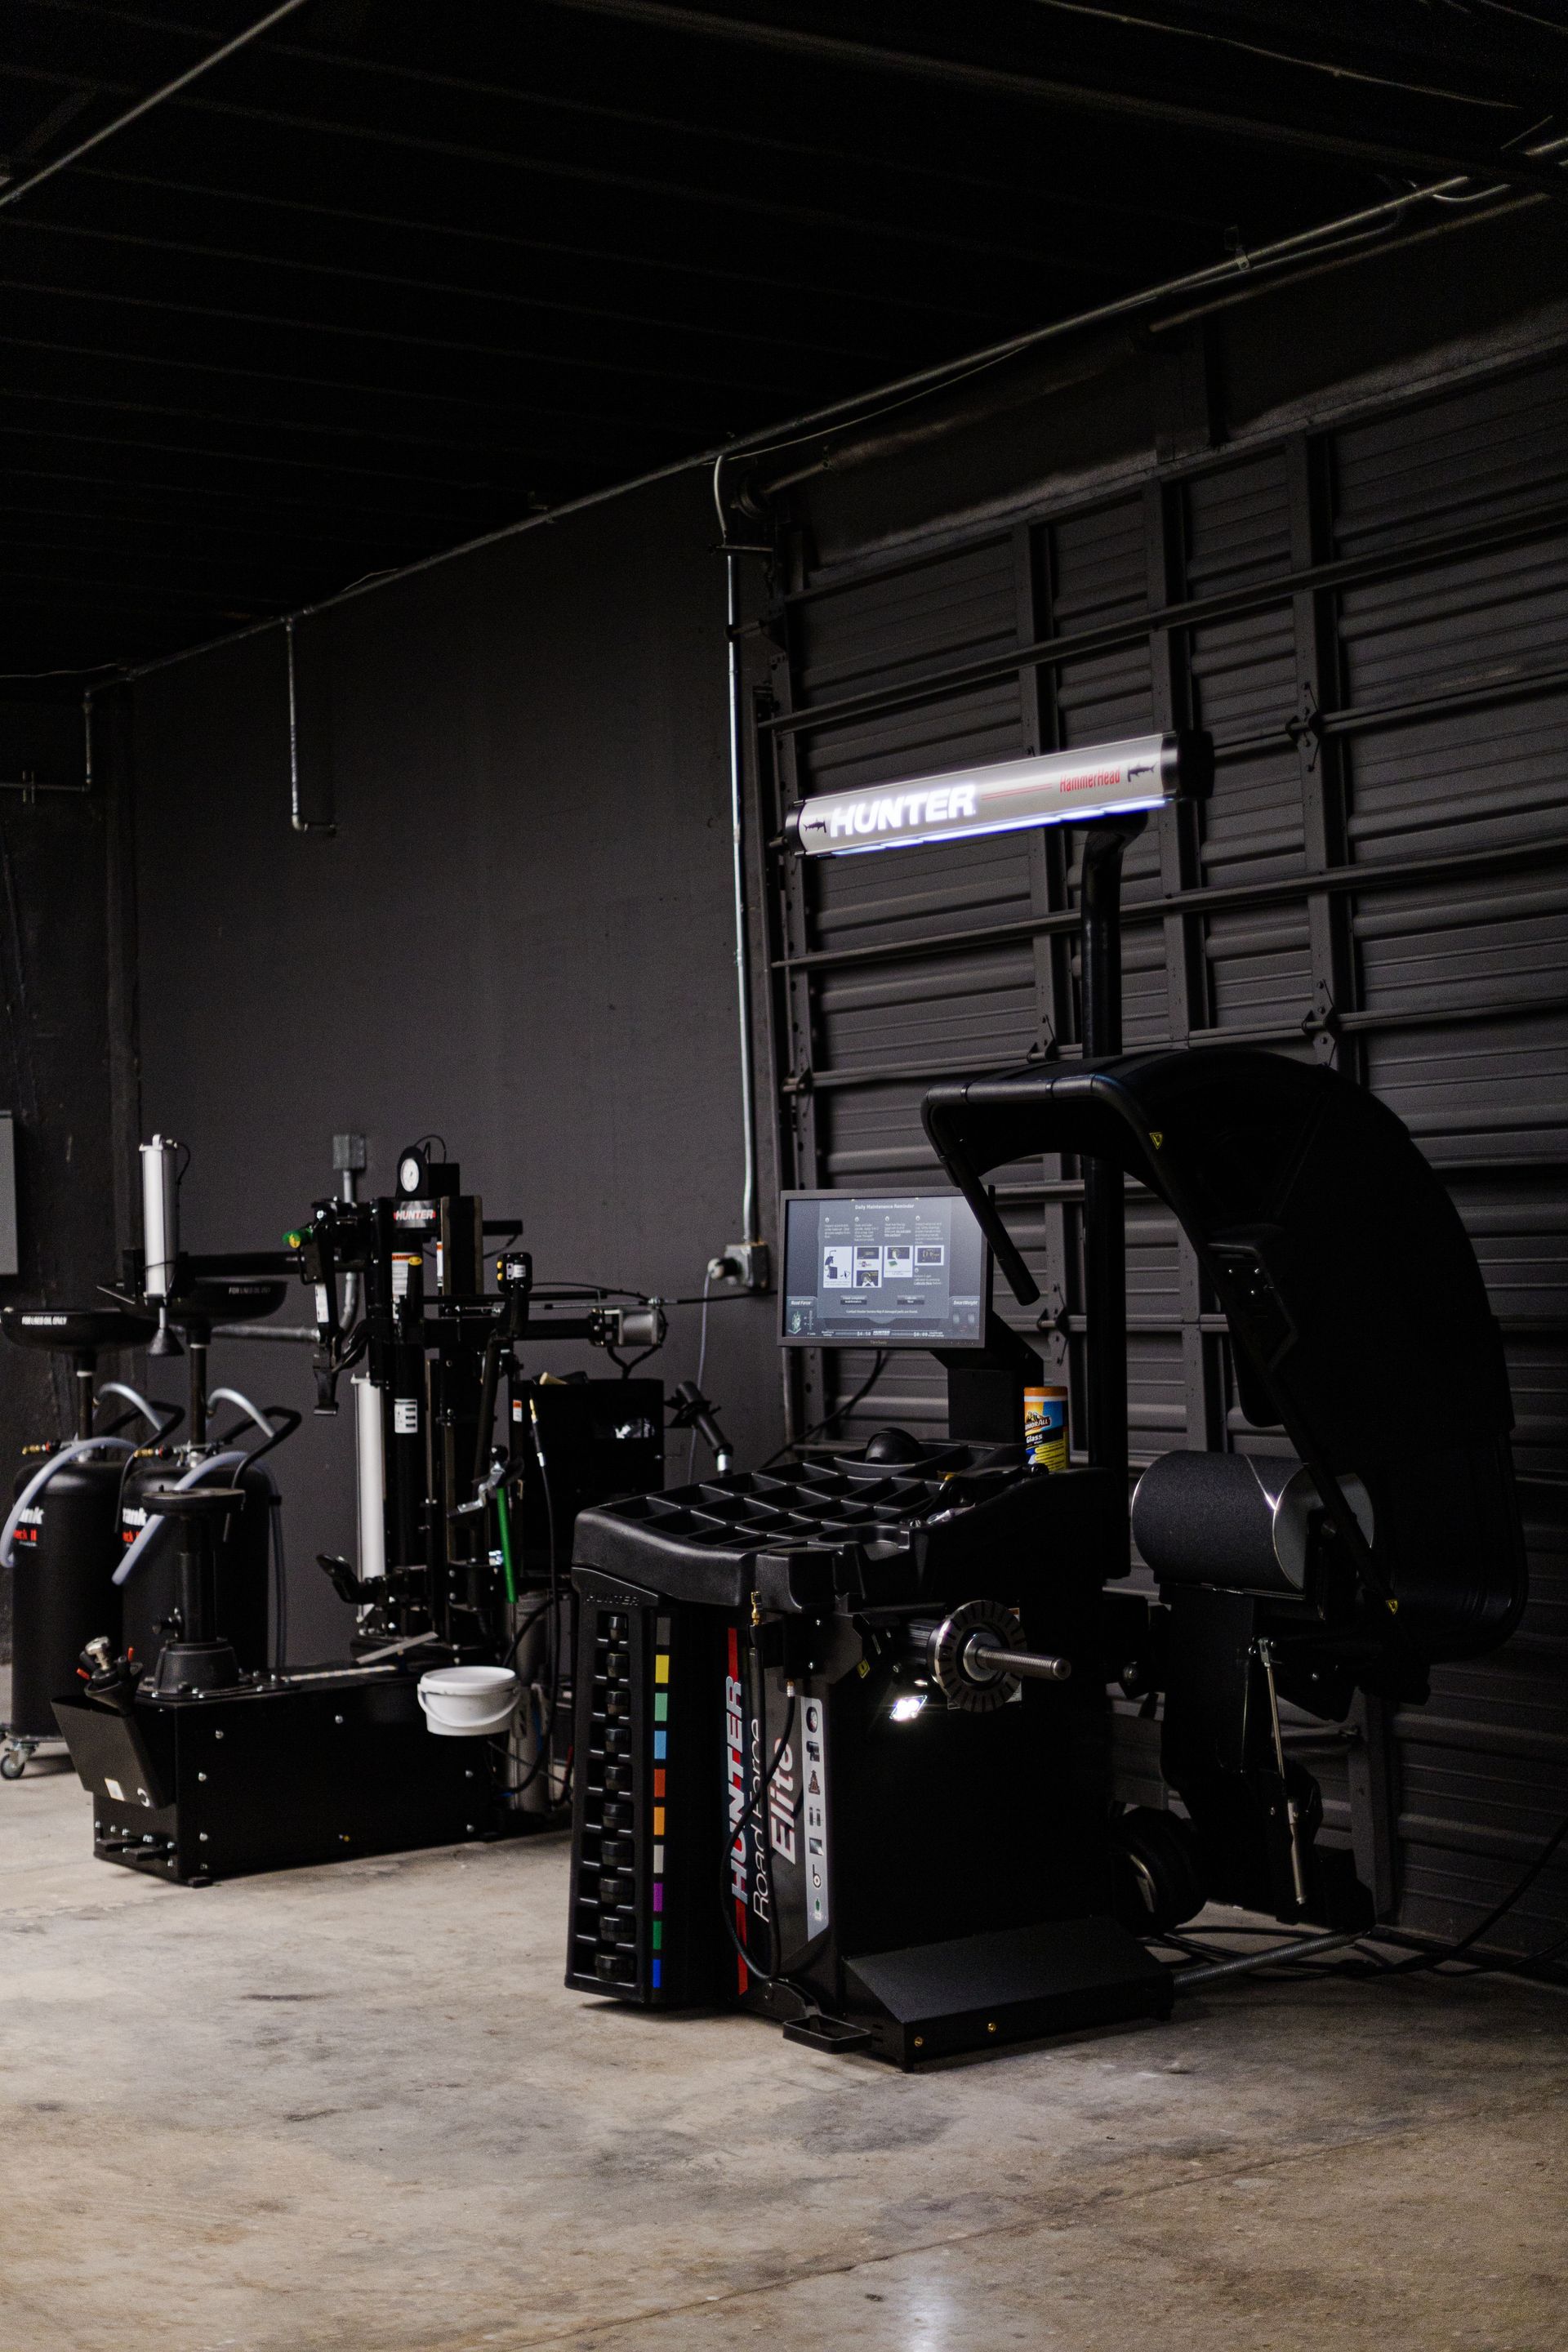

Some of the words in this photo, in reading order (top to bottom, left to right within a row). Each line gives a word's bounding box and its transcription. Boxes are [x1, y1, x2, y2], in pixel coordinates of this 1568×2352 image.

[830, 784, 977, 838] HUNTER
[1060, 768, 1121, 794] HammerHead
[395, 1209, 434, 1221] HUNTER
[1026, 1434, 1043, 1443] Glass
[586, 1595, 639, 1607] HUNTER
[727, 1675, 748, 1904] HUNTER
[749, 1717, 764, 1820] Force
[769, 1736, 796, 1865] Elite
[750, 1823, 770, 1923] Road
